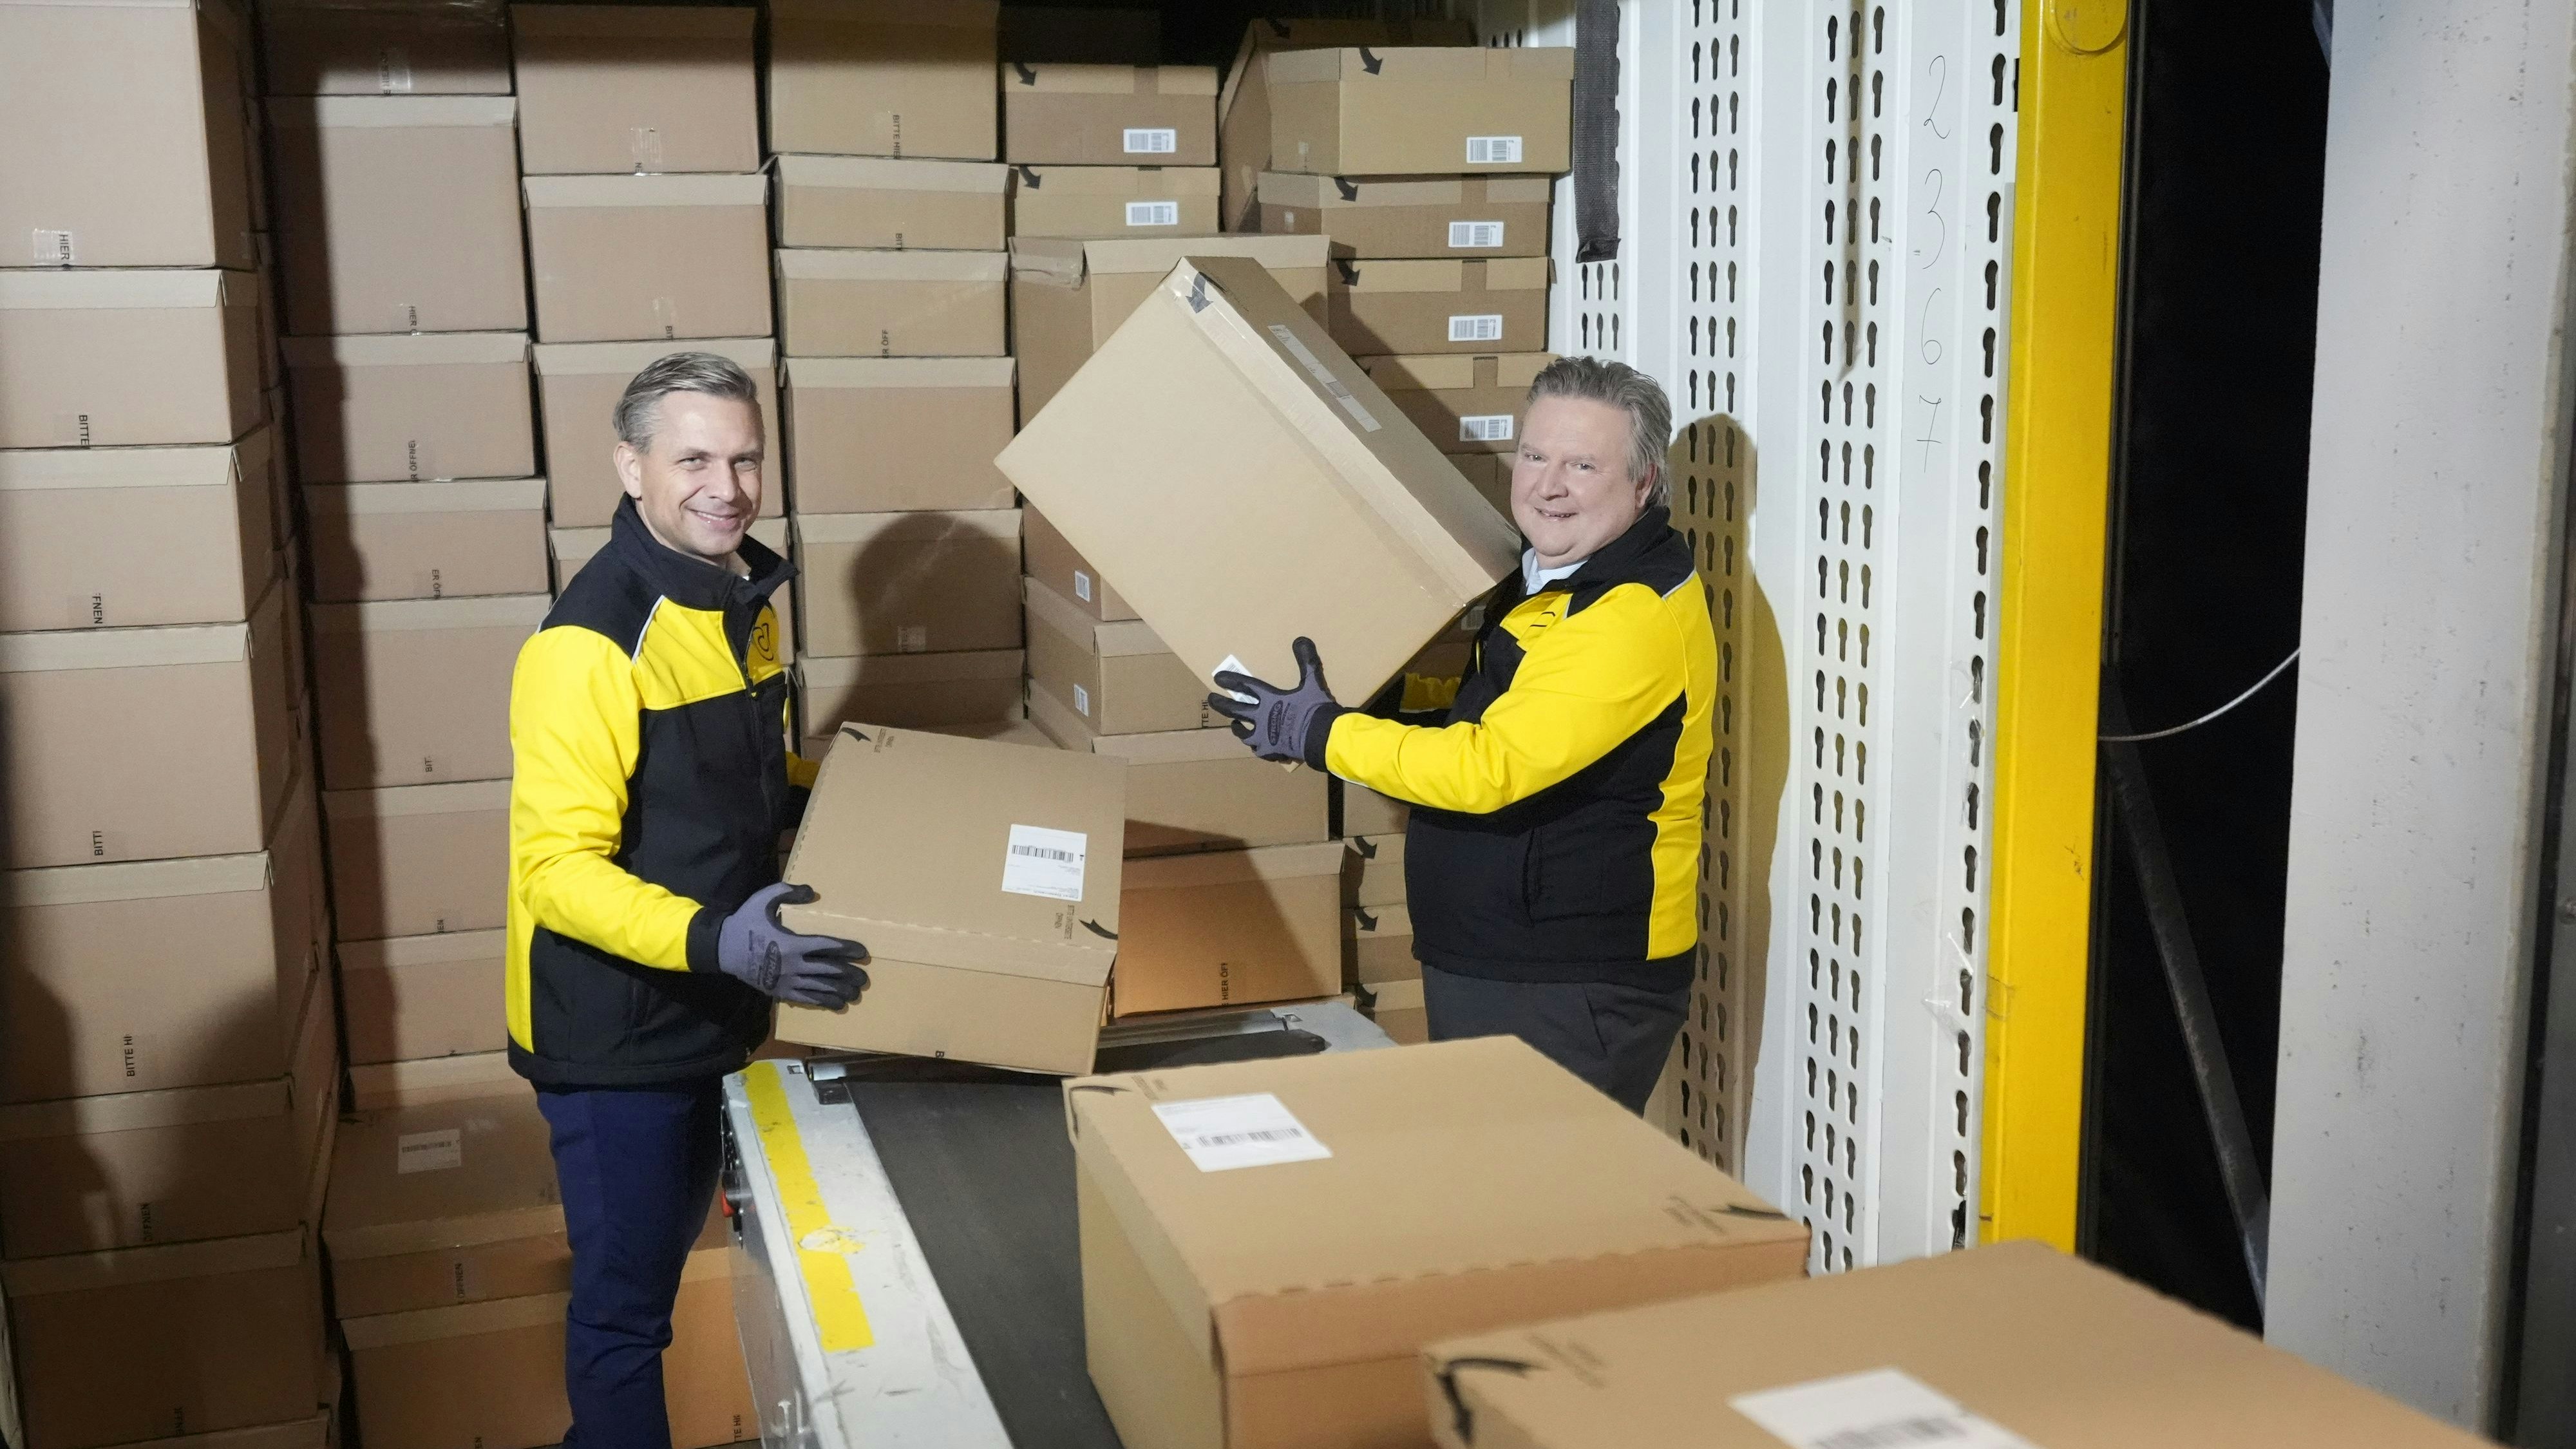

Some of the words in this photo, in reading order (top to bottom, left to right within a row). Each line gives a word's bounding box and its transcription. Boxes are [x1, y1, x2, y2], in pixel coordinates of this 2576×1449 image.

[59, 234, 70, 260] HIER
[408, 306, 417, 327] HIER
[79, 415, 90, 446] BITTE
[126, 1048, 135, 1077] BITTE
